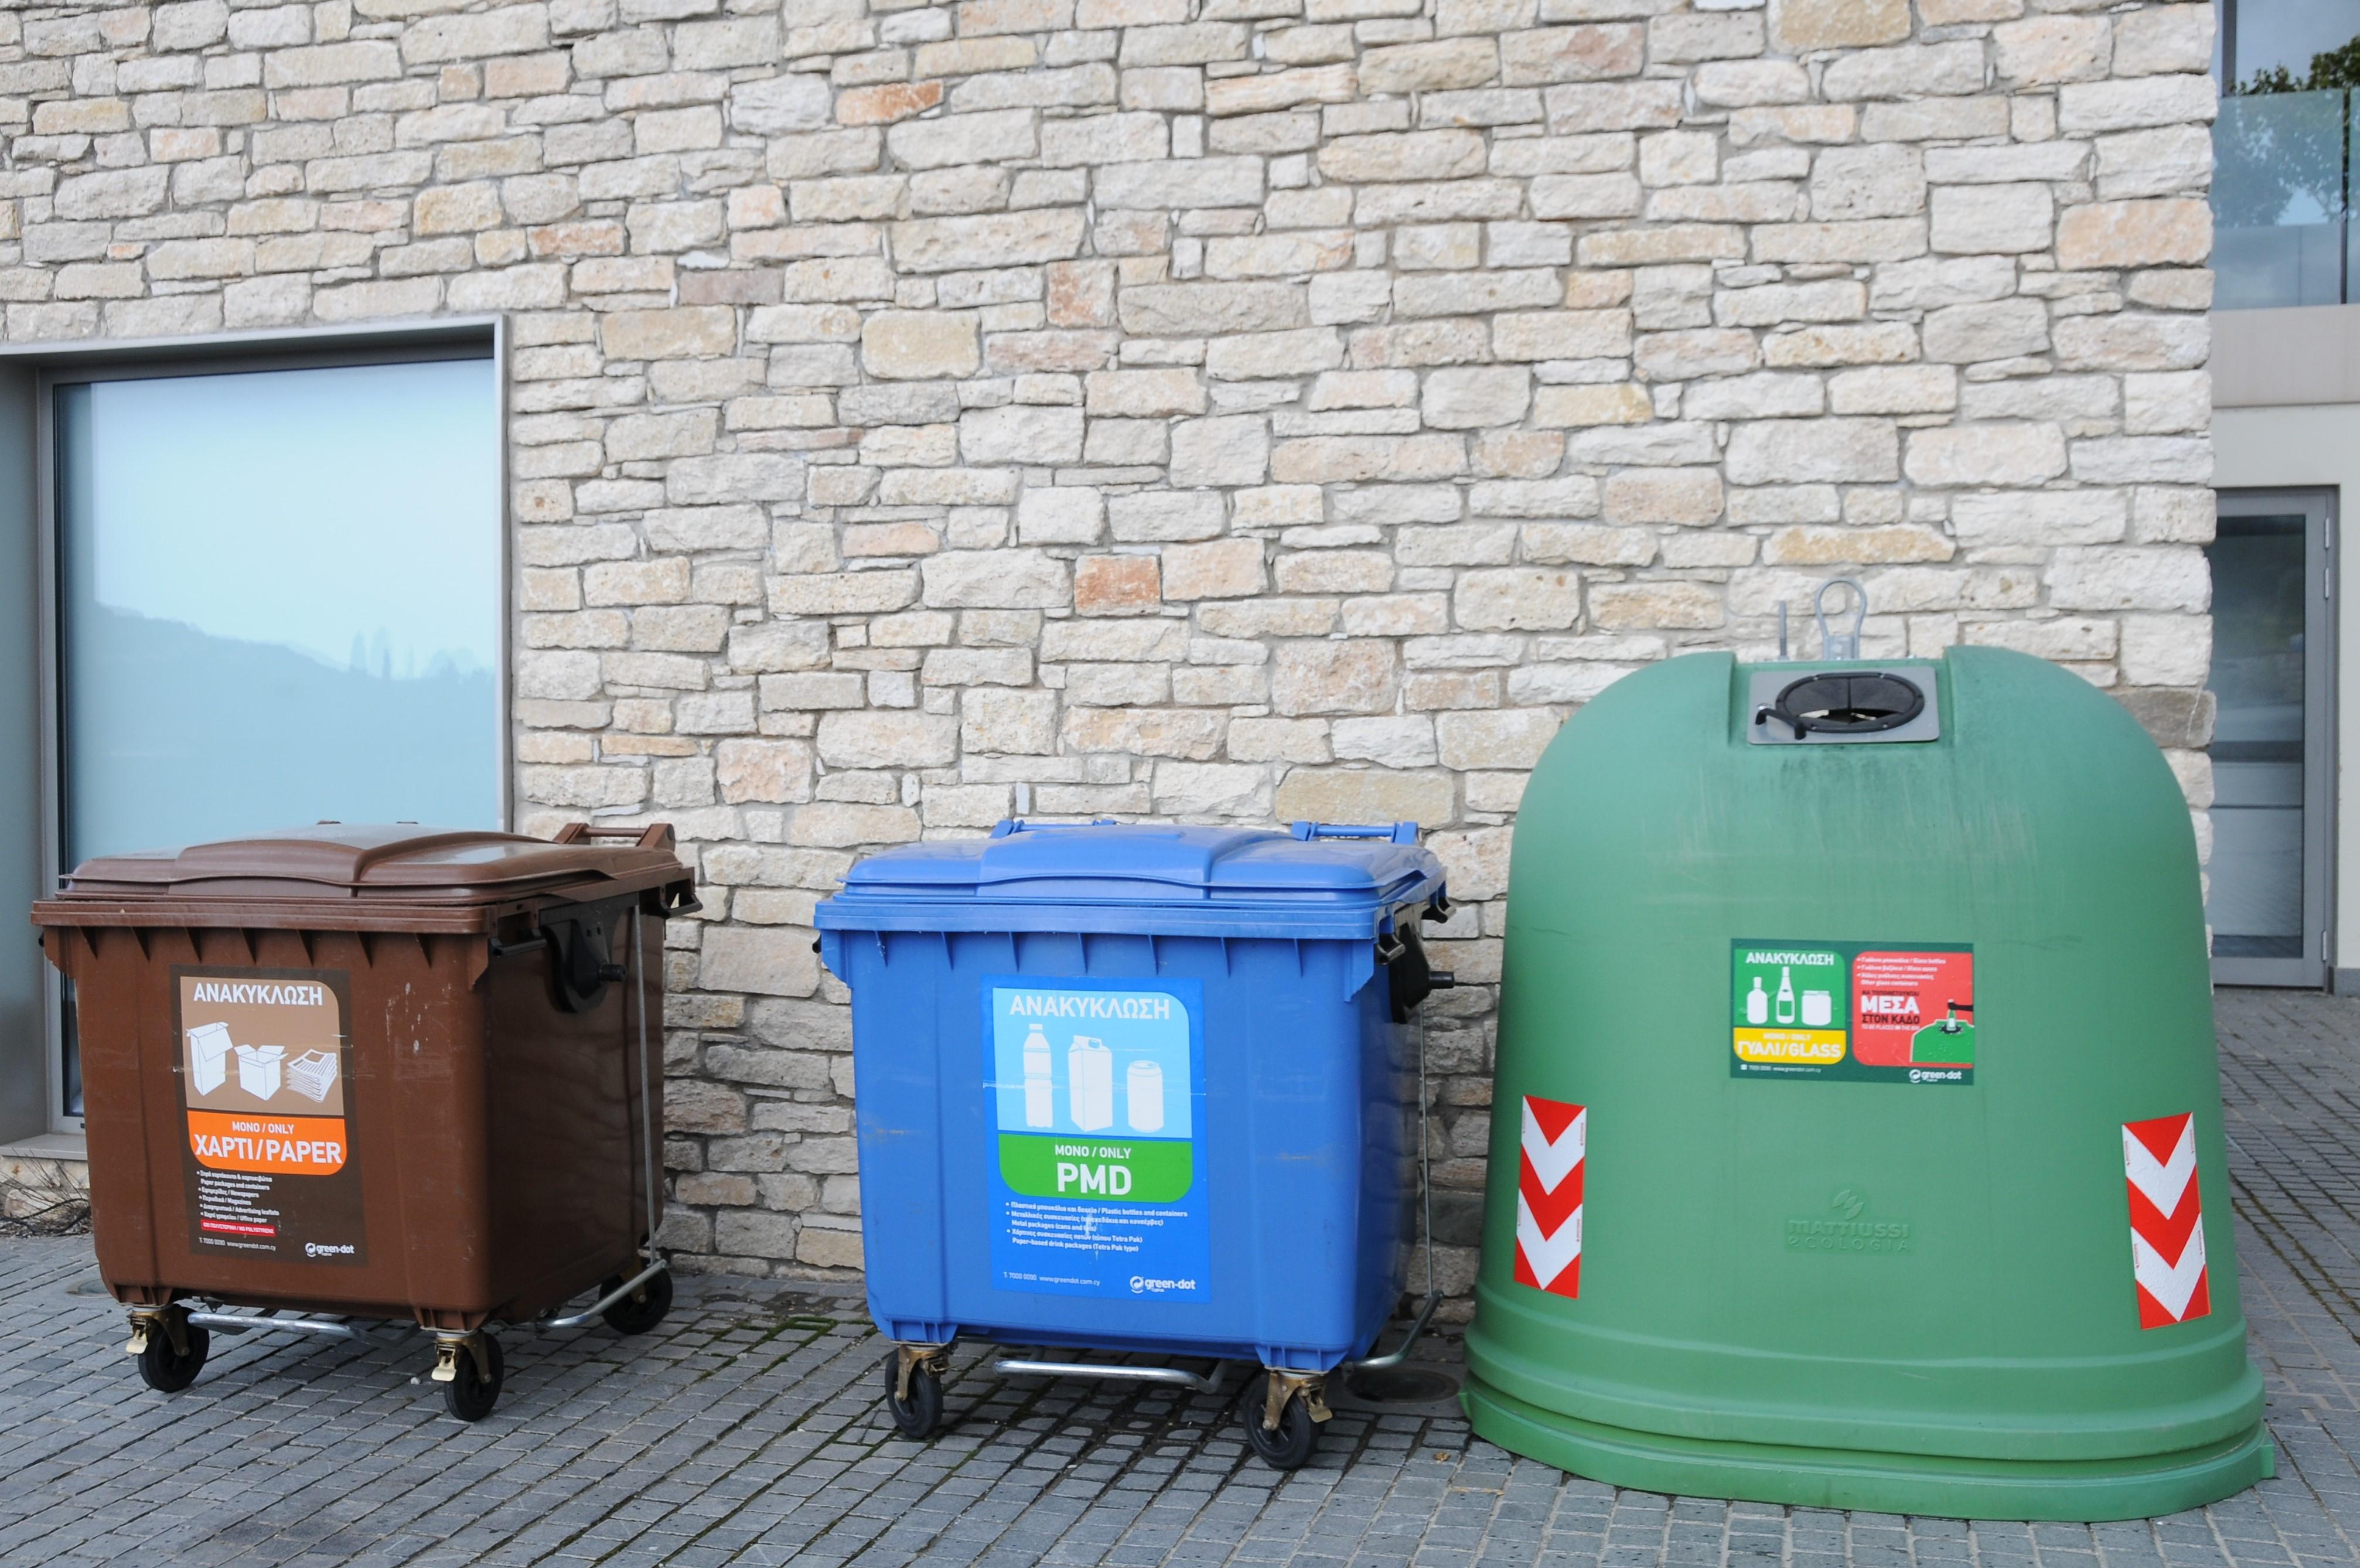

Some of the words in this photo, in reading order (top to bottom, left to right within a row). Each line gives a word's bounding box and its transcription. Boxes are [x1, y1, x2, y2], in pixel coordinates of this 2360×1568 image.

[1745, 952, 1834, 966] ΑΝΑΚΥΚΛΩΣΗ
[193, 983, 323, 1006] ΑΝΑΚΥΚΛΩΣΗ
[1010, 995, 1169, 1020] ΑΝΑΚΥΚΛΩΣΗ
[1861, 995, 1920, 1014] ΜΕΣΑ
[1862, 1014, 1888, 1023] ΣΤΟΝ
[1891, 1014, 1920, 1024] ΚΑΔΟ
[268, 1123, 295, 1135] ONLY
[1099, 1147, 1131, 1159] ONLY
[1057, 1163, 1133, 1195] PMD
[1028, 1221, 1055, 1229] packages
[1012, 1237, 1048, 1246] Paper-based
[1065, 1242, 1092, 1250] packages
[316, 1245, 354, 1255] green-dot
[1039, 1276, 1100, 1286] www.greendot.com.cy
[1145, 1279, 1196, 1290] green-dot
